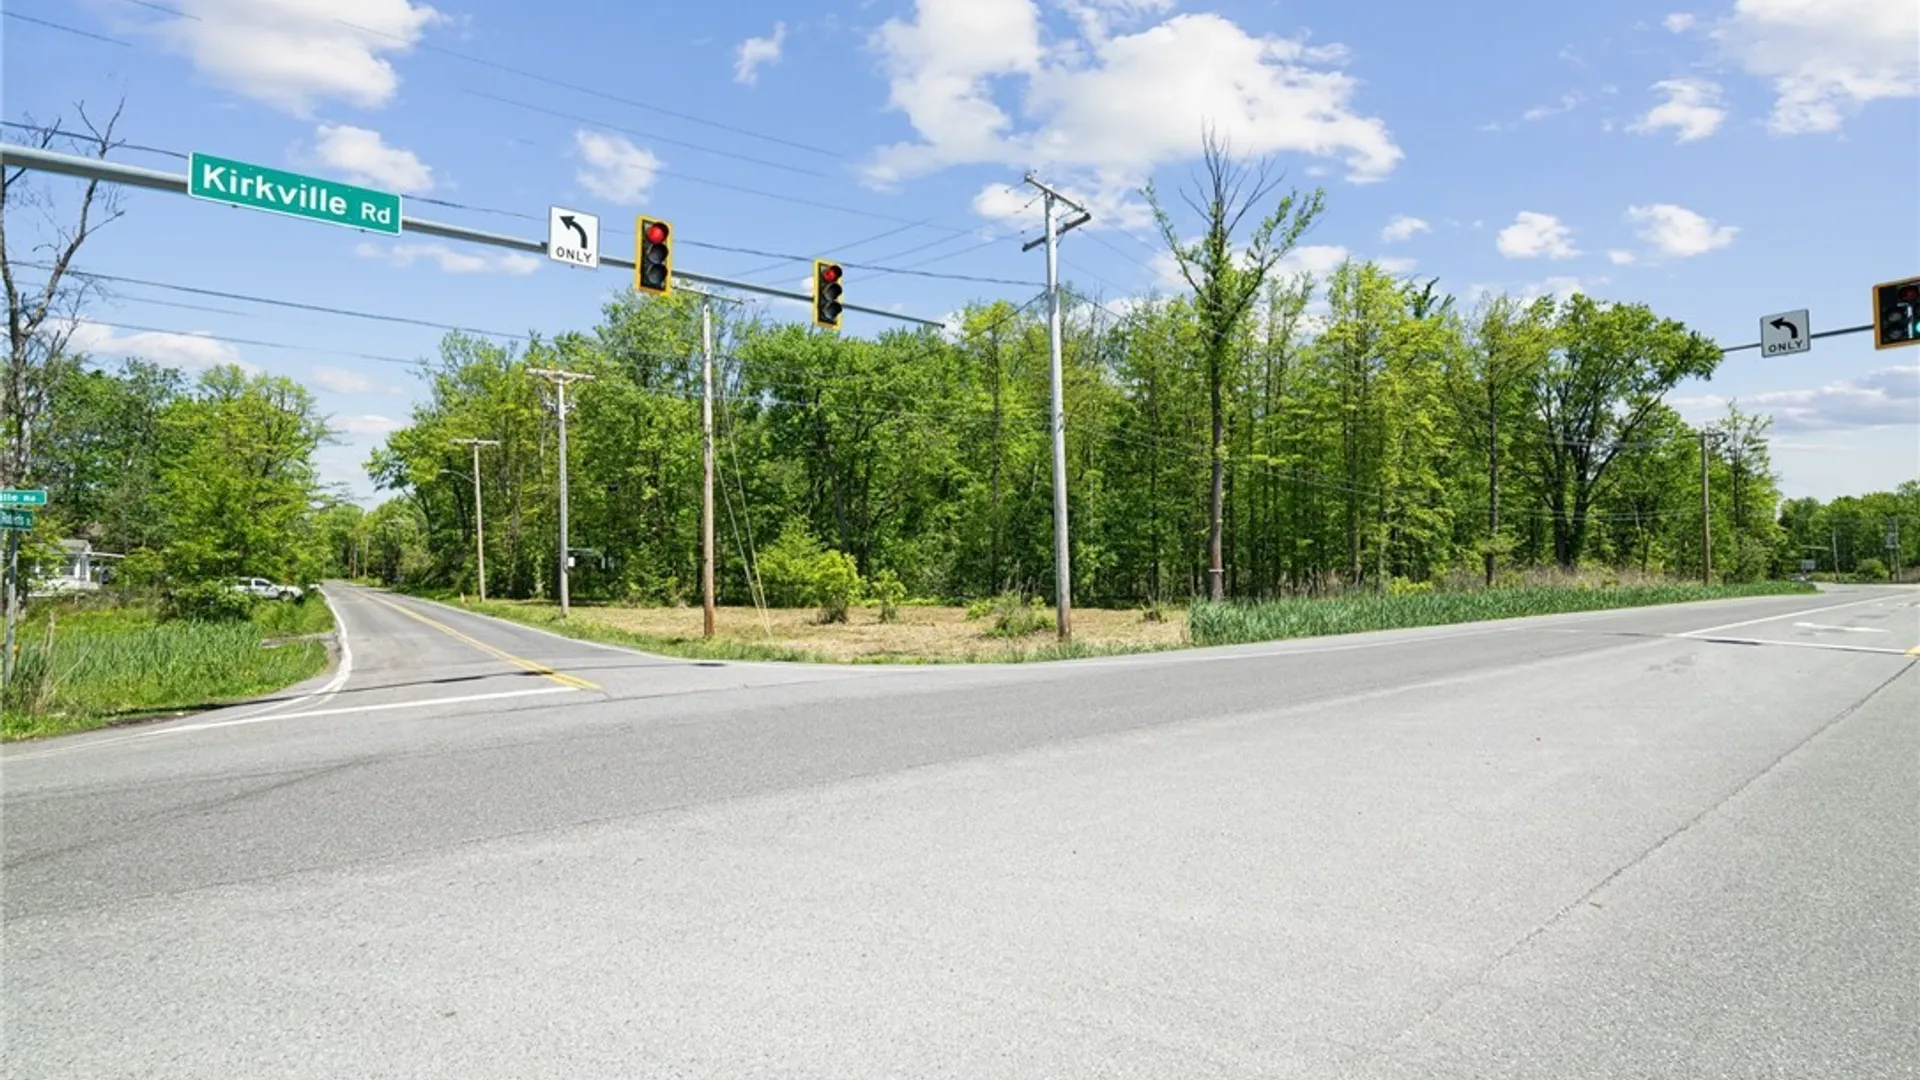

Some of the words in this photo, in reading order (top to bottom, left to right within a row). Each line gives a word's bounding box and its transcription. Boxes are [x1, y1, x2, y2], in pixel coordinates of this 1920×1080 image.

[203, 163, 347, 215] Kirkville
[361, 202, 390, 224] Rd
[556, 246, 592, 263] ONLY
[1768, 339, 1803, 353] ONLY
